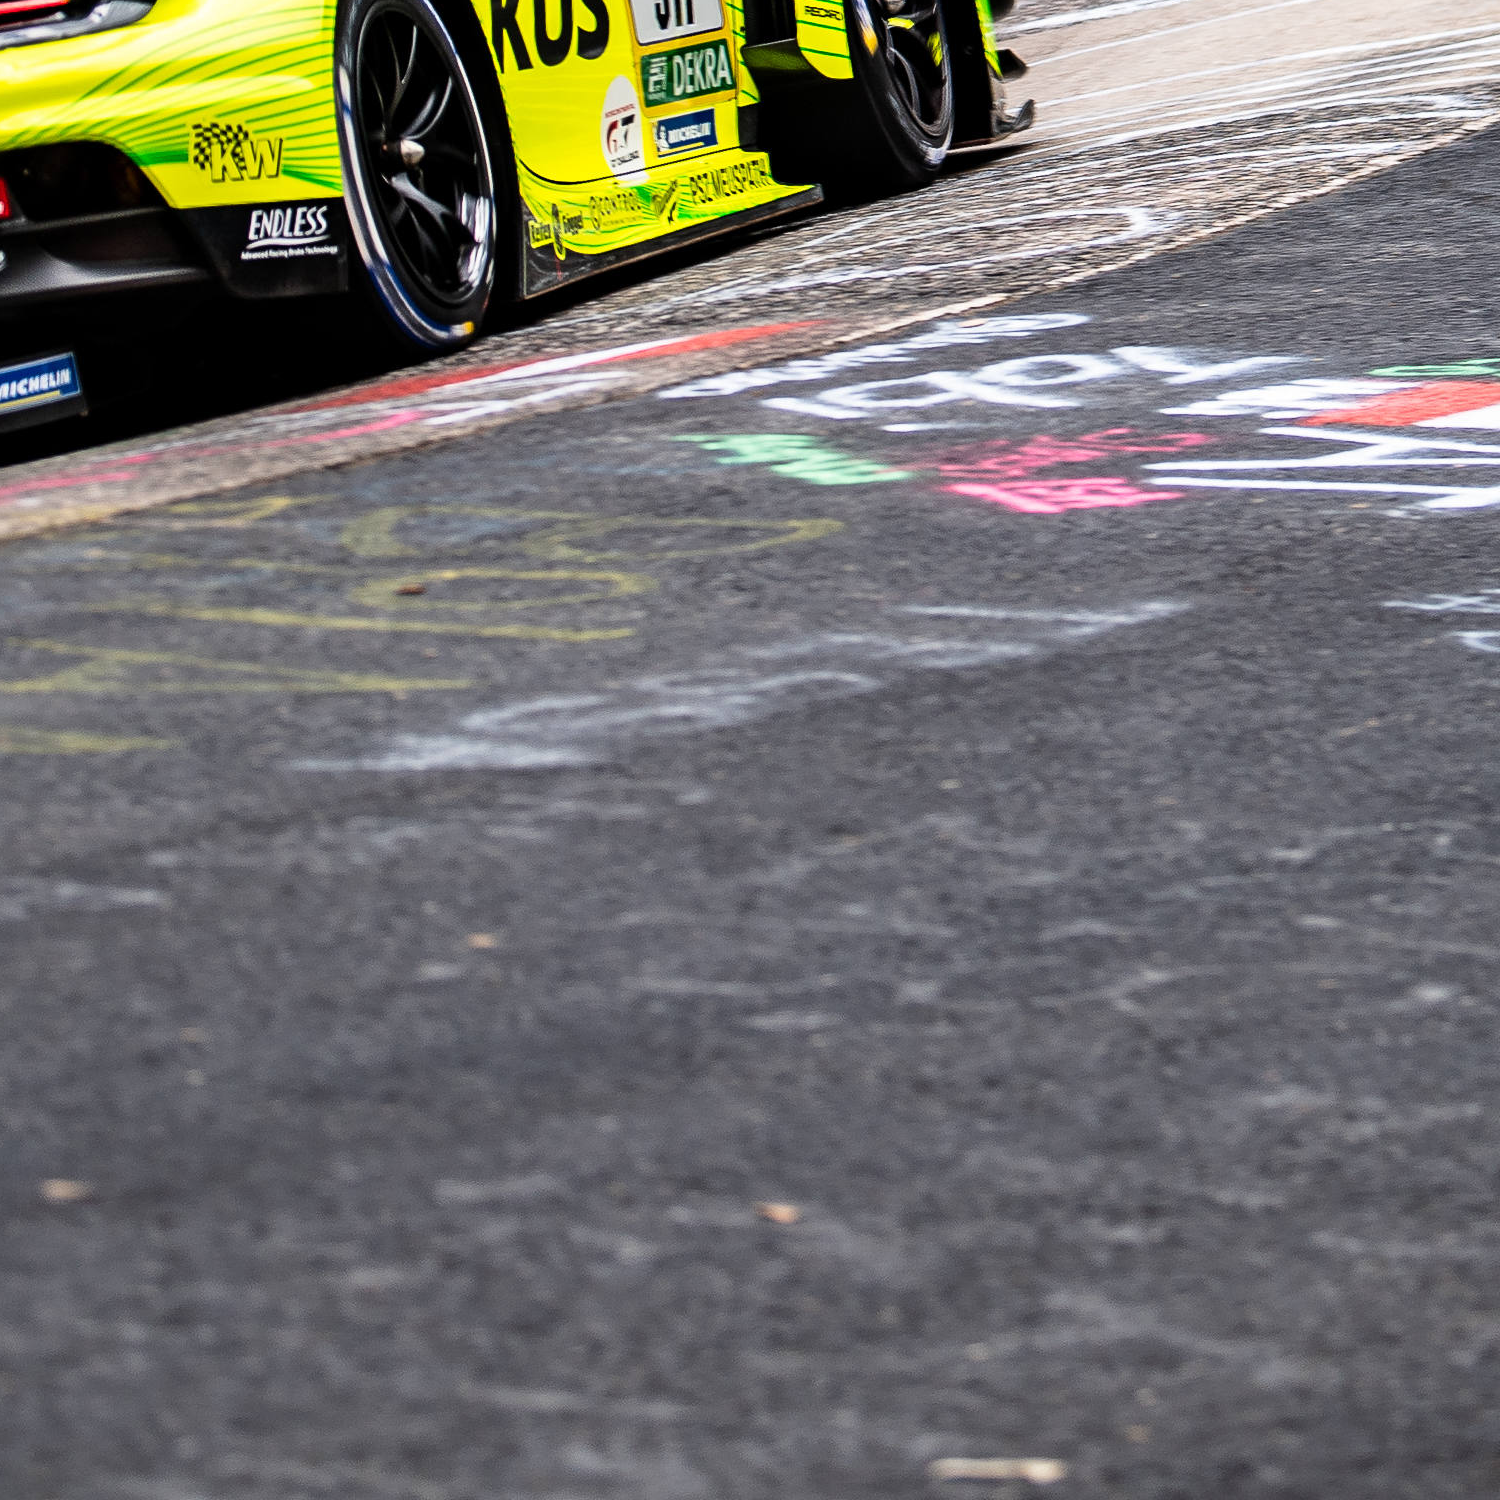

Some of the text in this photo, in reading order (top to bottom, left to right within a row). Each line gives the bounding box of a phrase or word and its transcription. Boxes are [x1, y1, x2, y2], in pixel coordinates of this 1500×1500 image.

[672, 44, 733, 97] DEKRA
[210, 136, 283, 184] KW
[247, 204, 329, 241] ENDLESS
